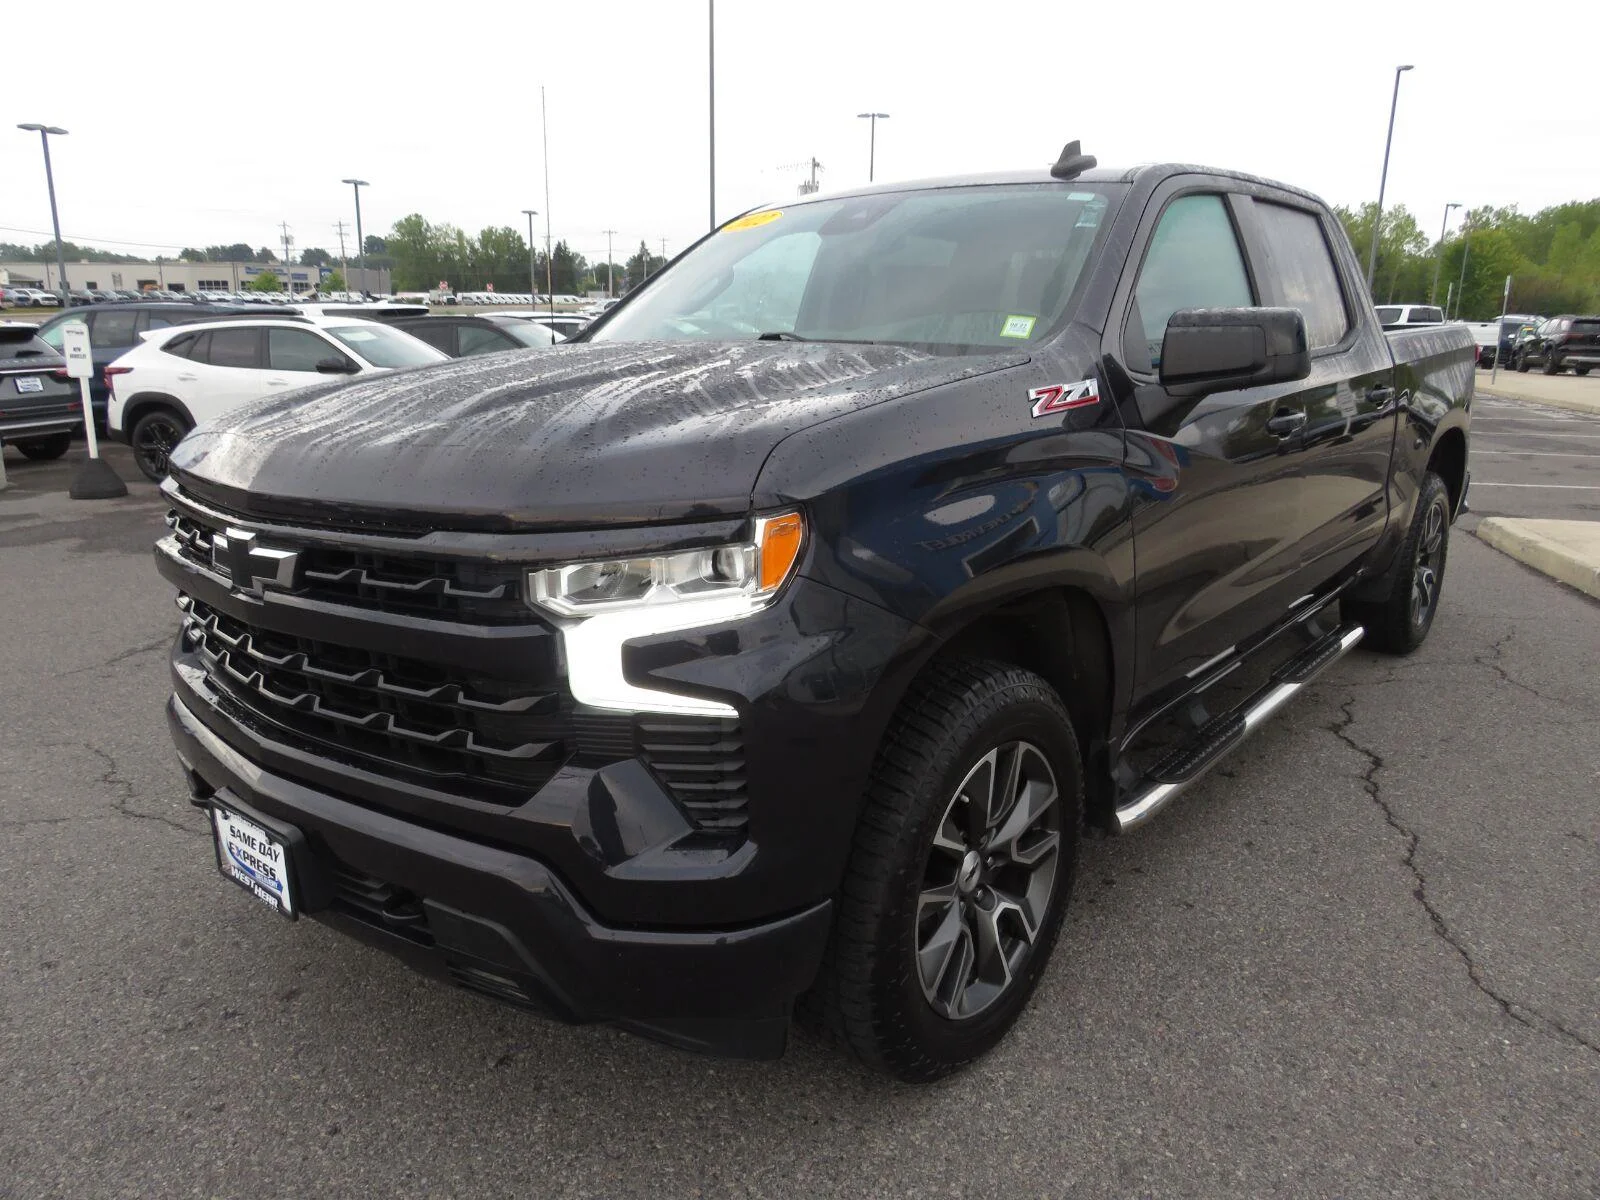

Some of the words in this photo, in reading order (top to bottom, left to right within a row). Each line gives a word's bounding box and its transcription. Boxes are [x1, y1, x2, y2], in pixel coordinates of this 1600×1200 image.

[1029, 378, 1099, 417] Z71
[227, 841, 277, 880] EXPRESS
[229, 825, 258, 849] SAME
[258, 842, 281, 863] DAY
[231, 866, 255, 889] WEST
[253, 886, 279, 908] HERR
